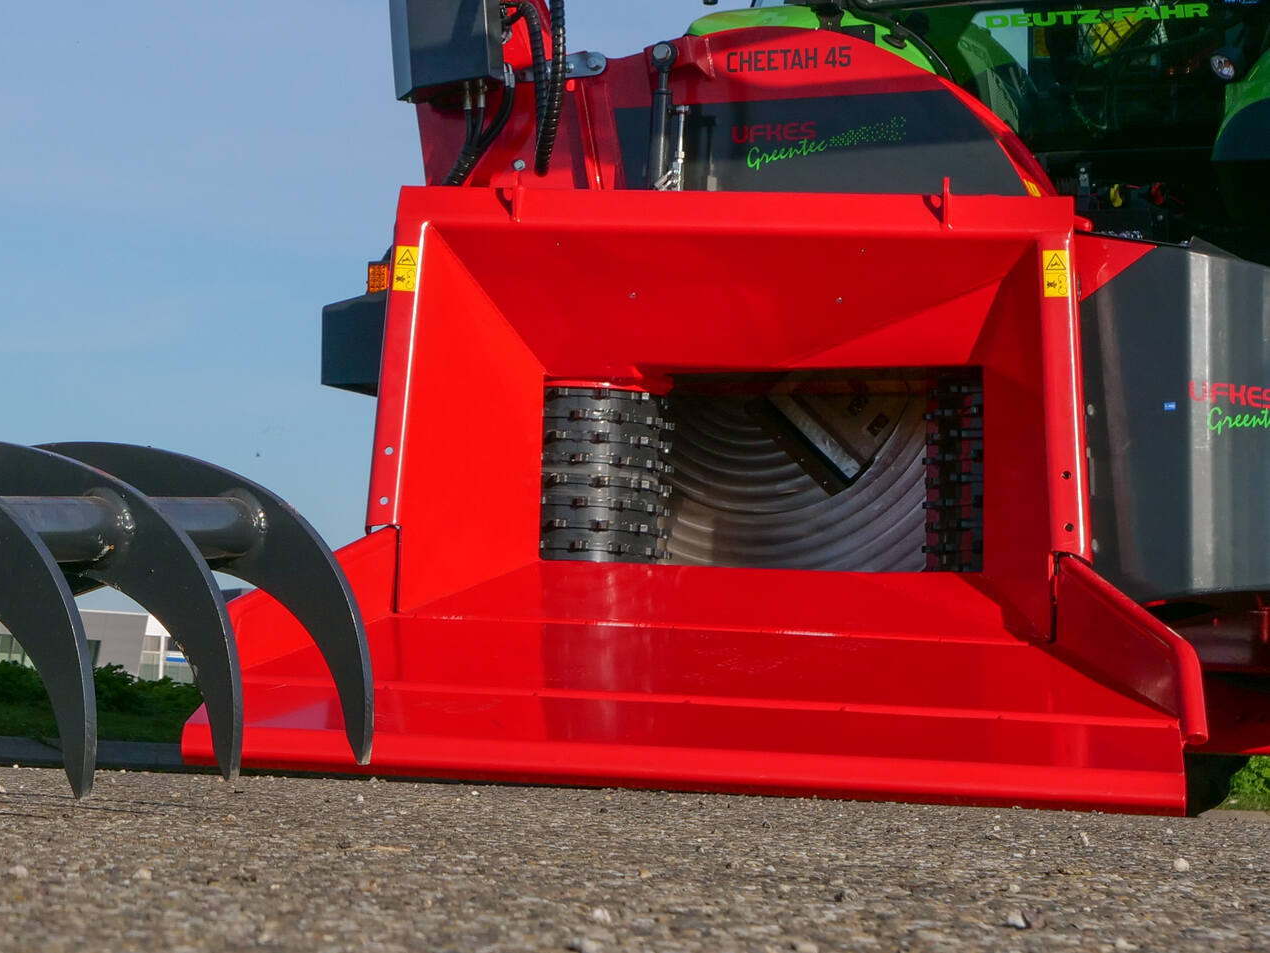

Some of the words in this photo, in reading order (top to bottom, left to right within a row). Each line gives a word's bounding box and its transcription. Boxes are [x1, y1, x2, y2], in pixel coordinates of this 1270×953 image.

[985, 3, 1209, 28] DEUTZ-FAHR
[726, 48, 818, 73] CHEETAH
[824, 45, 852, 68] 45
[732, 120, 818, 144] UFKES
[746, 137, 828, 171] Greentec
